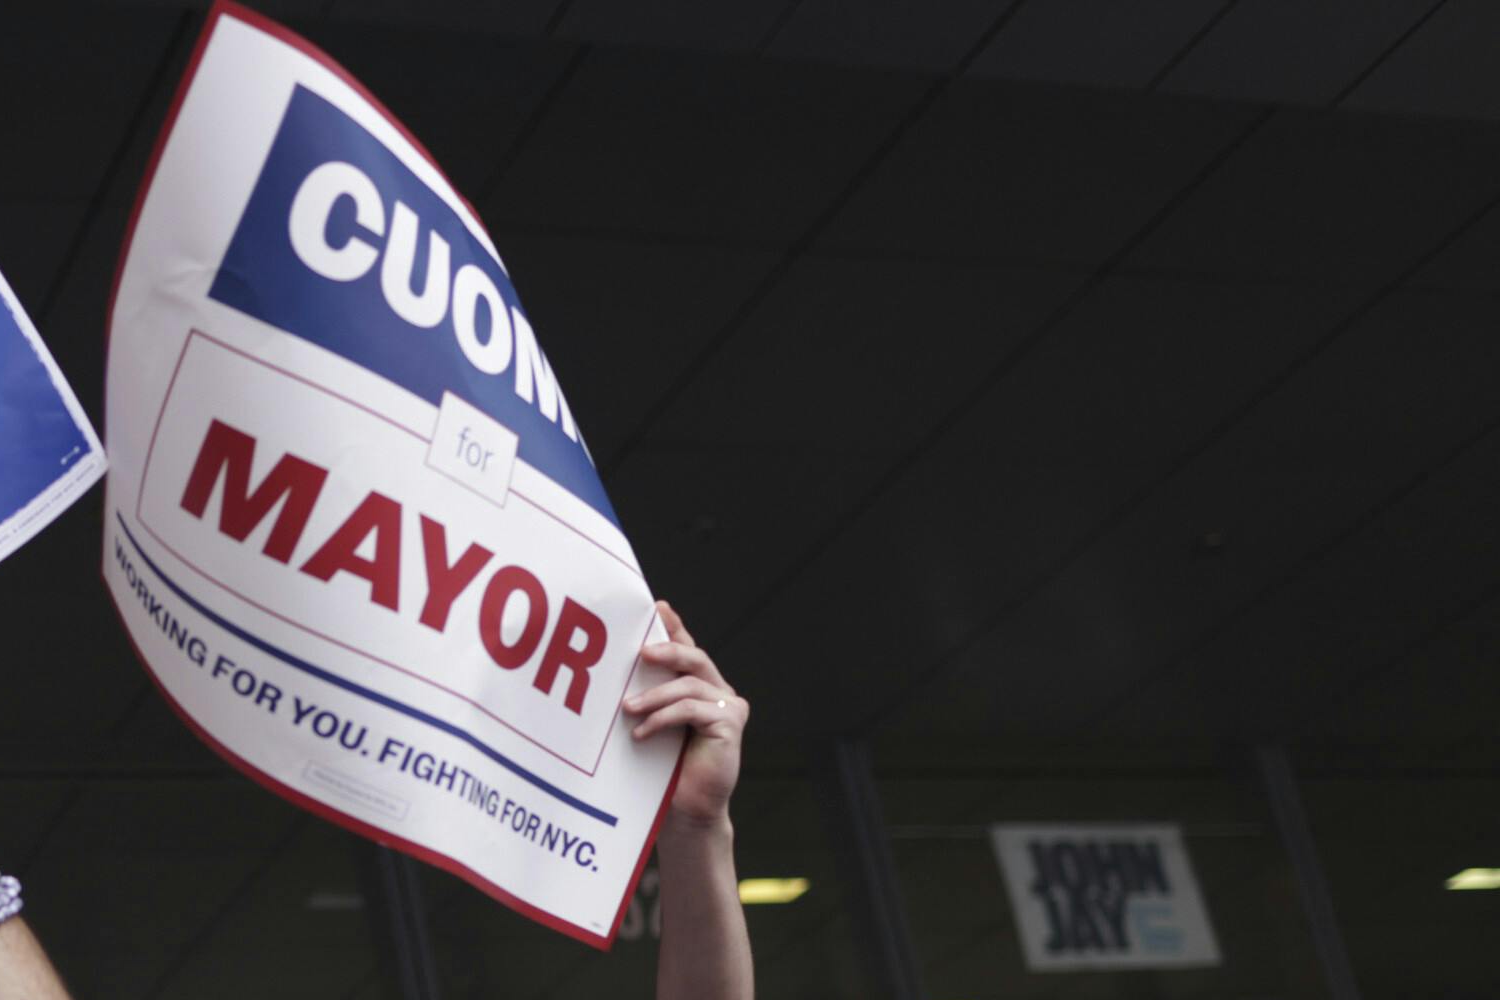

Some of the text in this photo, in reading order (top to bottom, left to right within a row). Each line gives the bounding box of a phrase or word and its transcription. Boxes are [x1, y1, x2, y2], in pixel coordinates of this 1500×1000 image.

[288, 160, 595, 468] CUOM
[455, 427, 495, 472] for
[179, 417, 608, 717] MAYOR
[115, 535, 208, 668] WORKING
[211, 654, 283, 714] FOR
[291, 697, 369, 757] YOU.
[377, 737, 500, 818] FIGHTING
[500, 798, 541, 843] FOR
[540, 823, 599, 873] NYC.
[1026, 839, 1171, 894] JOHN
[1045, 886, 1132, 953] JAY
